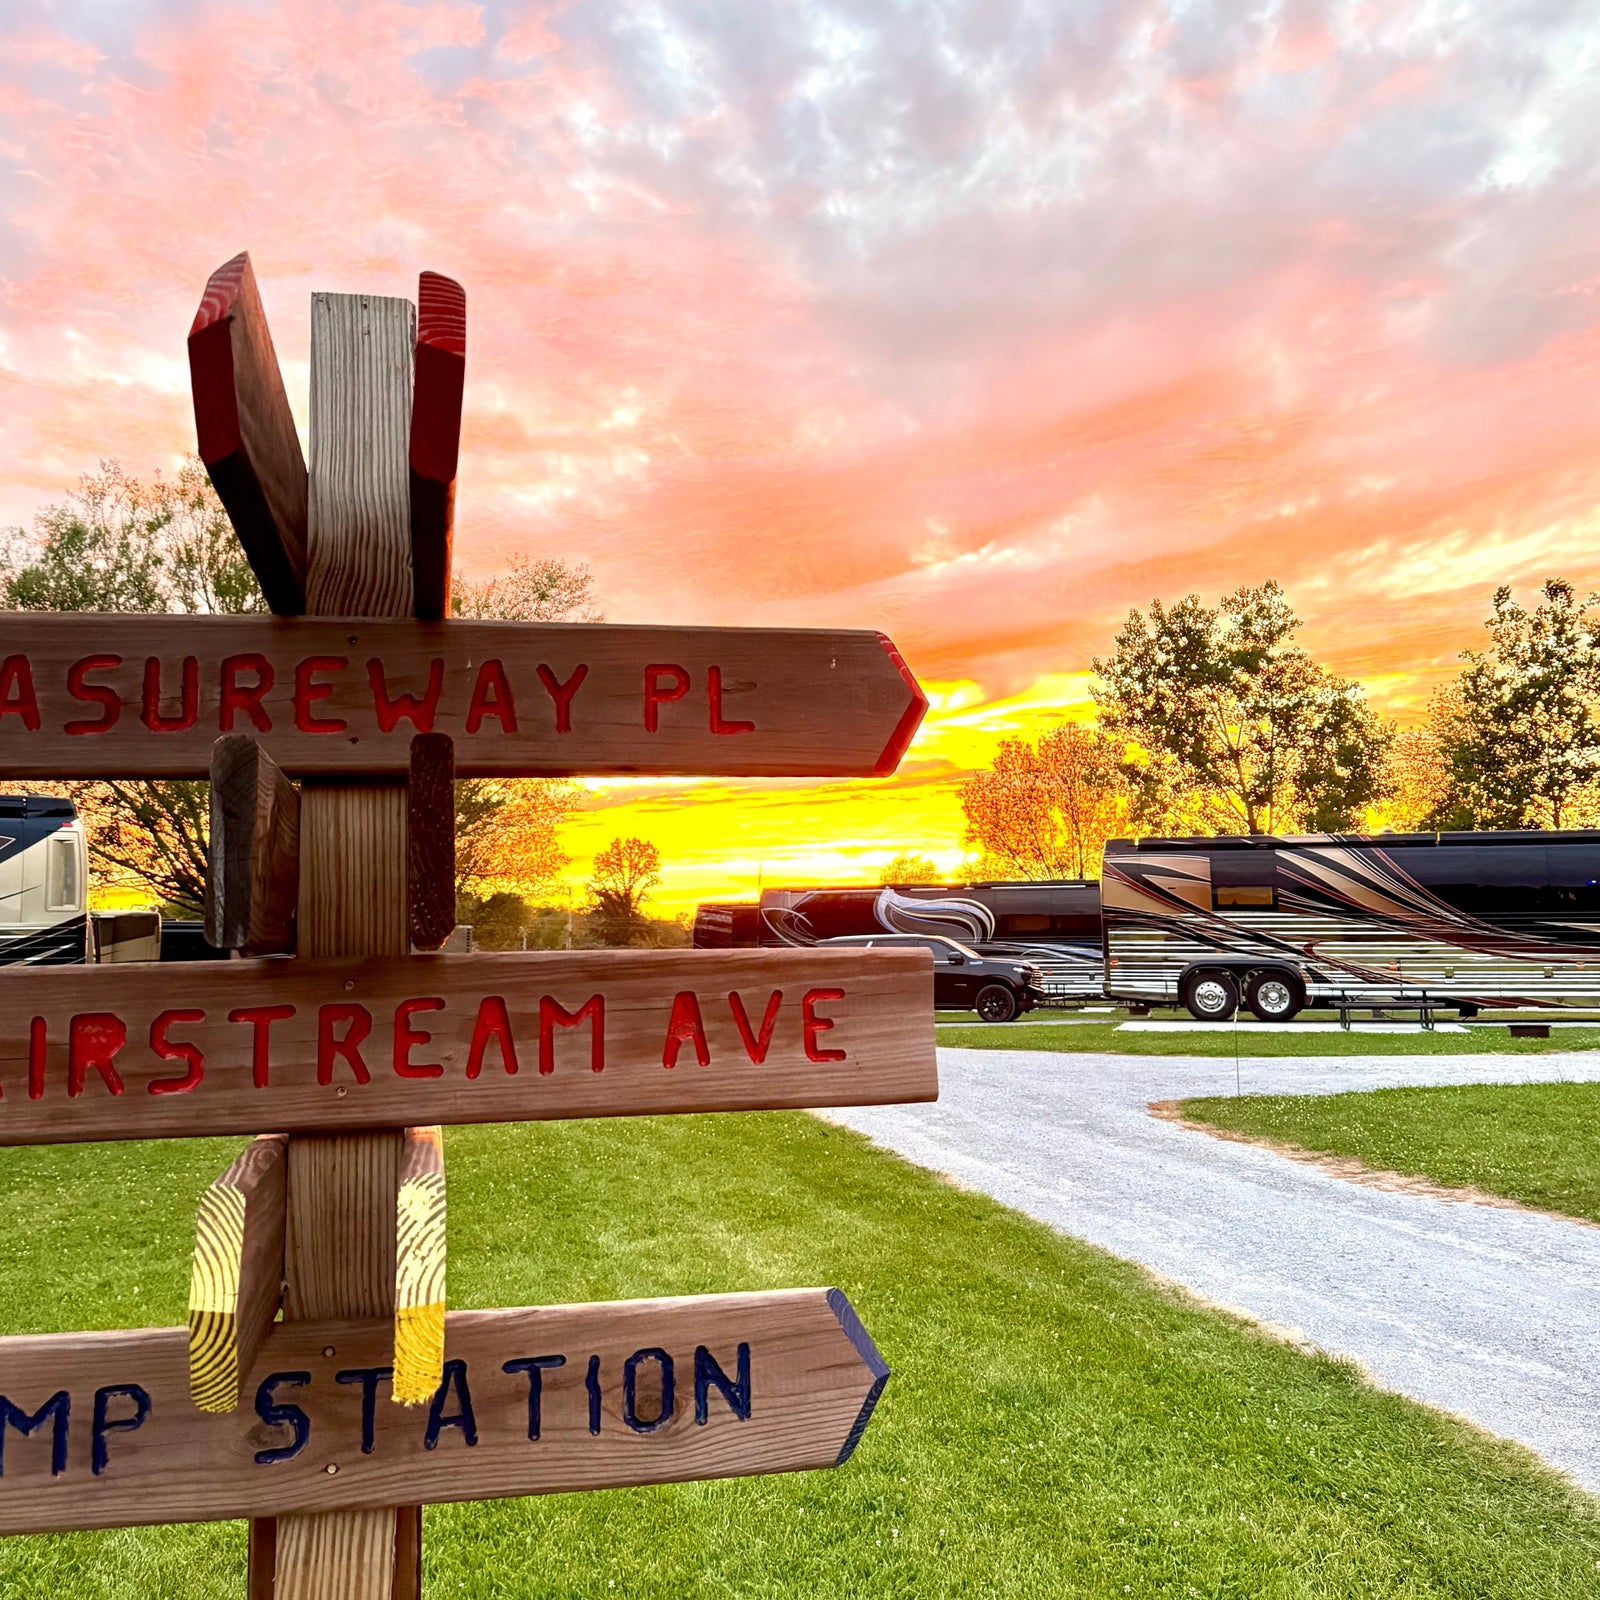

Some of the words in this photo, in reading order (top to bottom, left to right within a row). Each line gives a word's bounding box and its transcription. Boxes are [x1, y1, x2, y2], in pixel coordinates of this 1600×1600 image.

[0, 652, 589, 736] ASUREWAY
[644, 663, 755, 735] PL
[0, 993, 605, 1100] IRSTREAM
[662, 987, 847, 1069] AVE
[0, 1383, 152, 1477] MP
[254, 1341, 752, 1464] STATION
